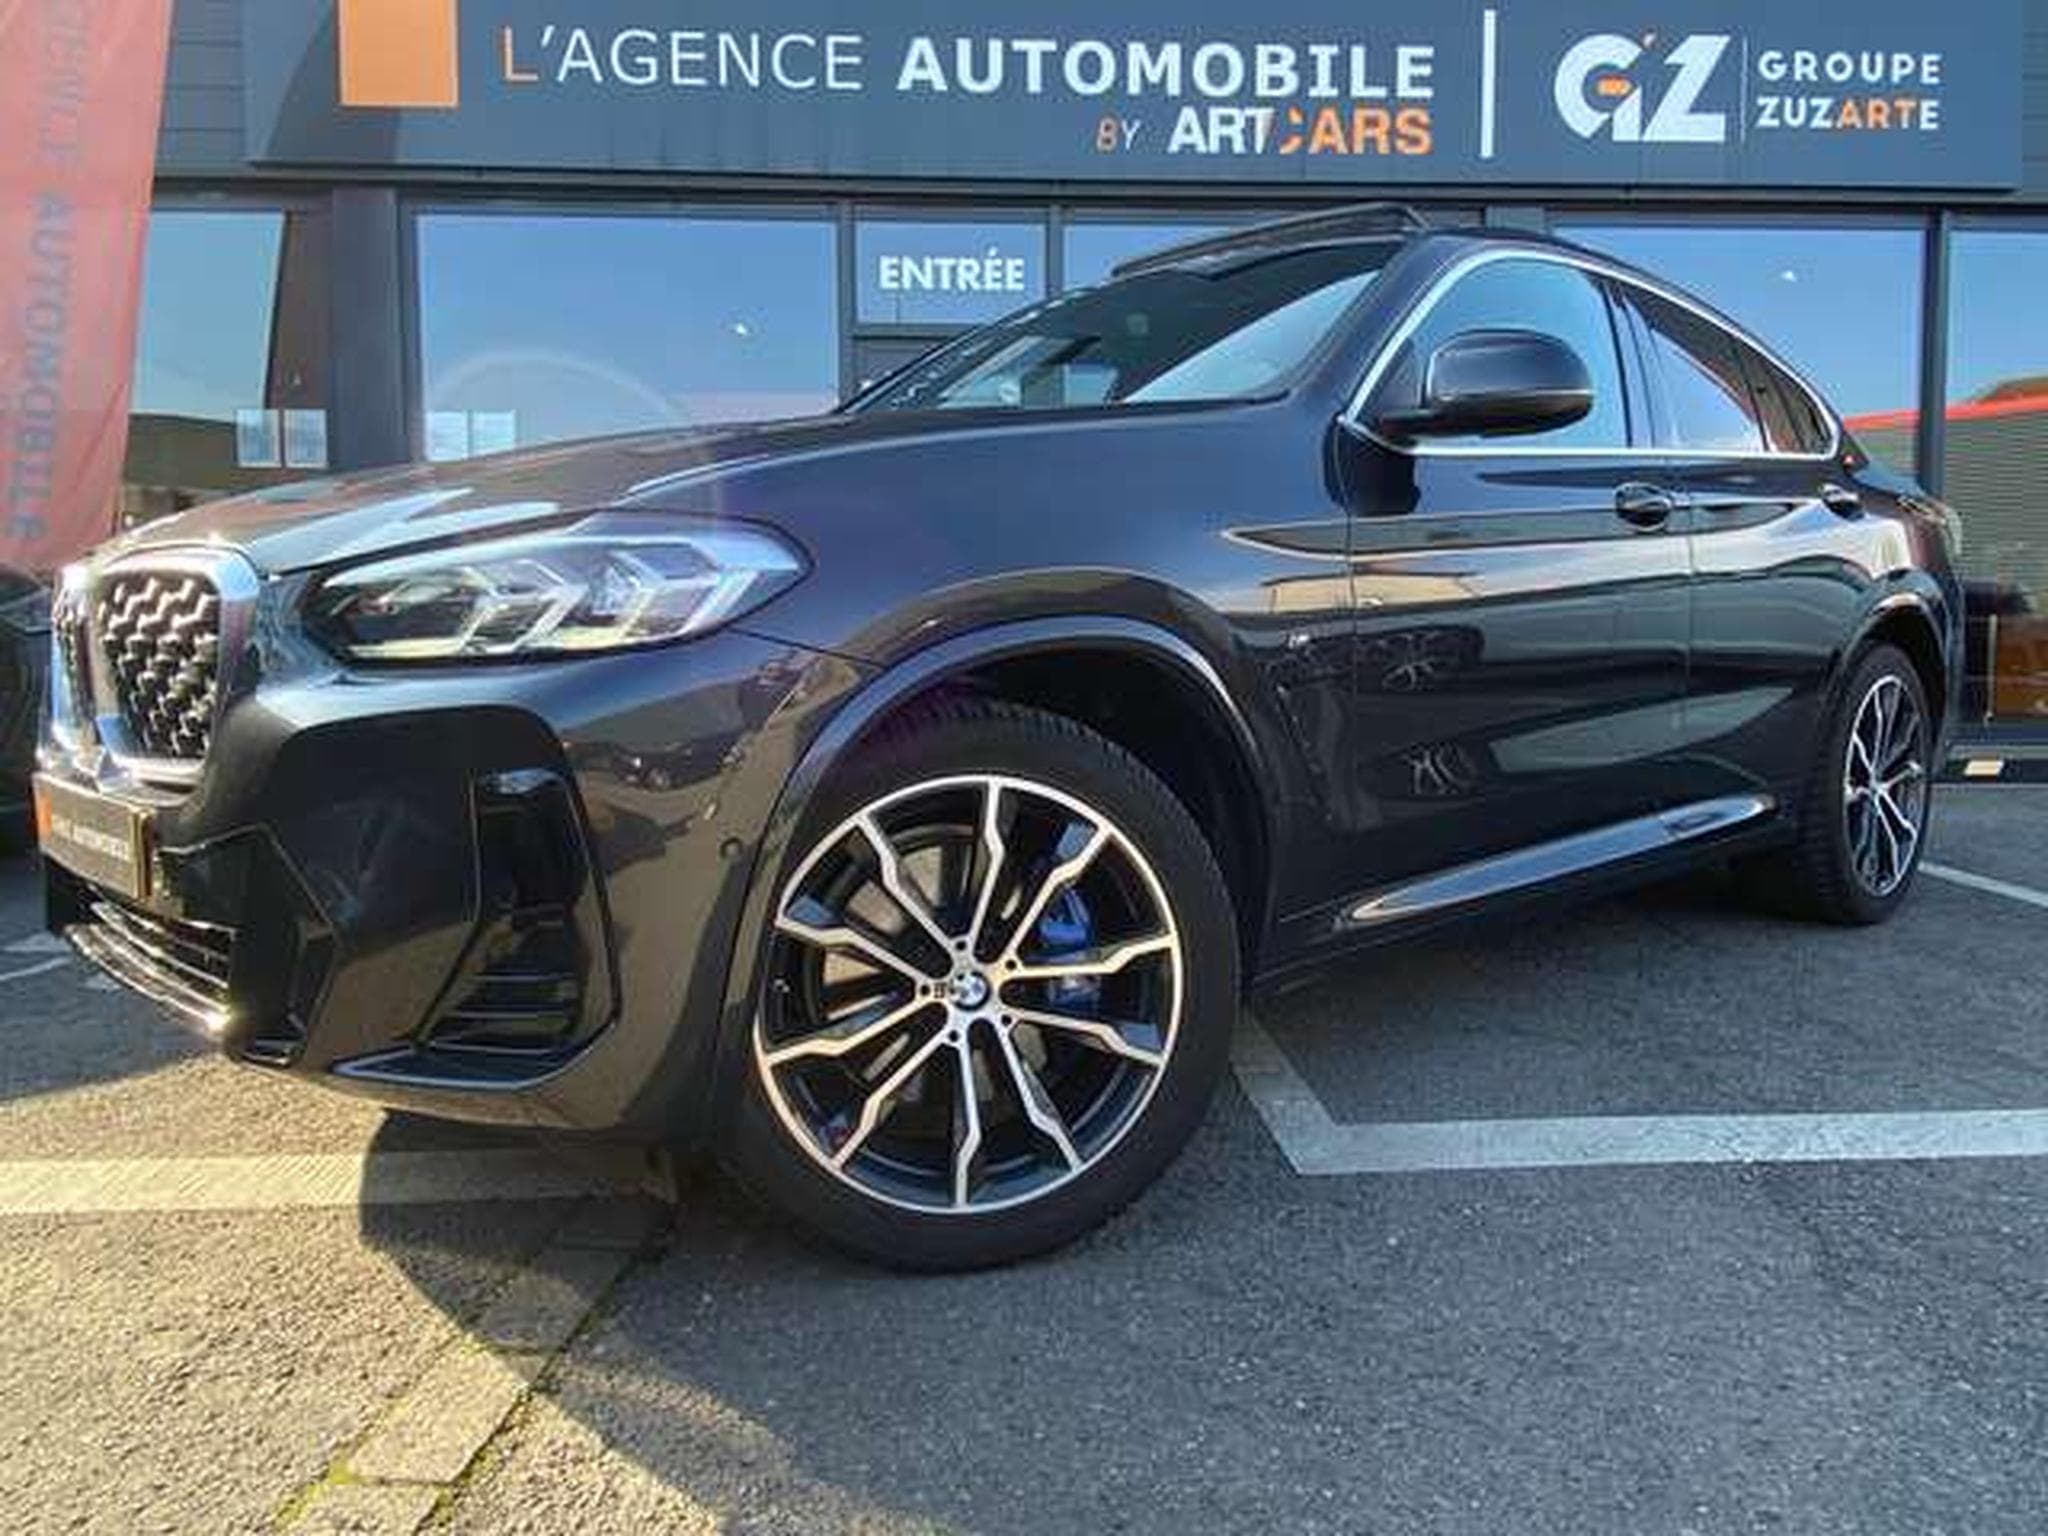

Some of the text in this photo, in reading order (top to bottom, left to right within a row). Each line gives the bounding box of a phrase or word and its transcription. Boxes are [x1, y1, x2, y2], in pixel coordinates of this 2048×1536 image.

[502, 25, 1435, 98] L'AGENCE AUTOMOBILE
[1757, 51, 1942, 84] GROUPE
[1757, 96, 1940, 130] ZUZARTE
[1096, 119, 1141, 153] BY
[879, 246, 1025, 291] ENTRÉE
[4, 190, 78, 538] AUTOMOBILE
